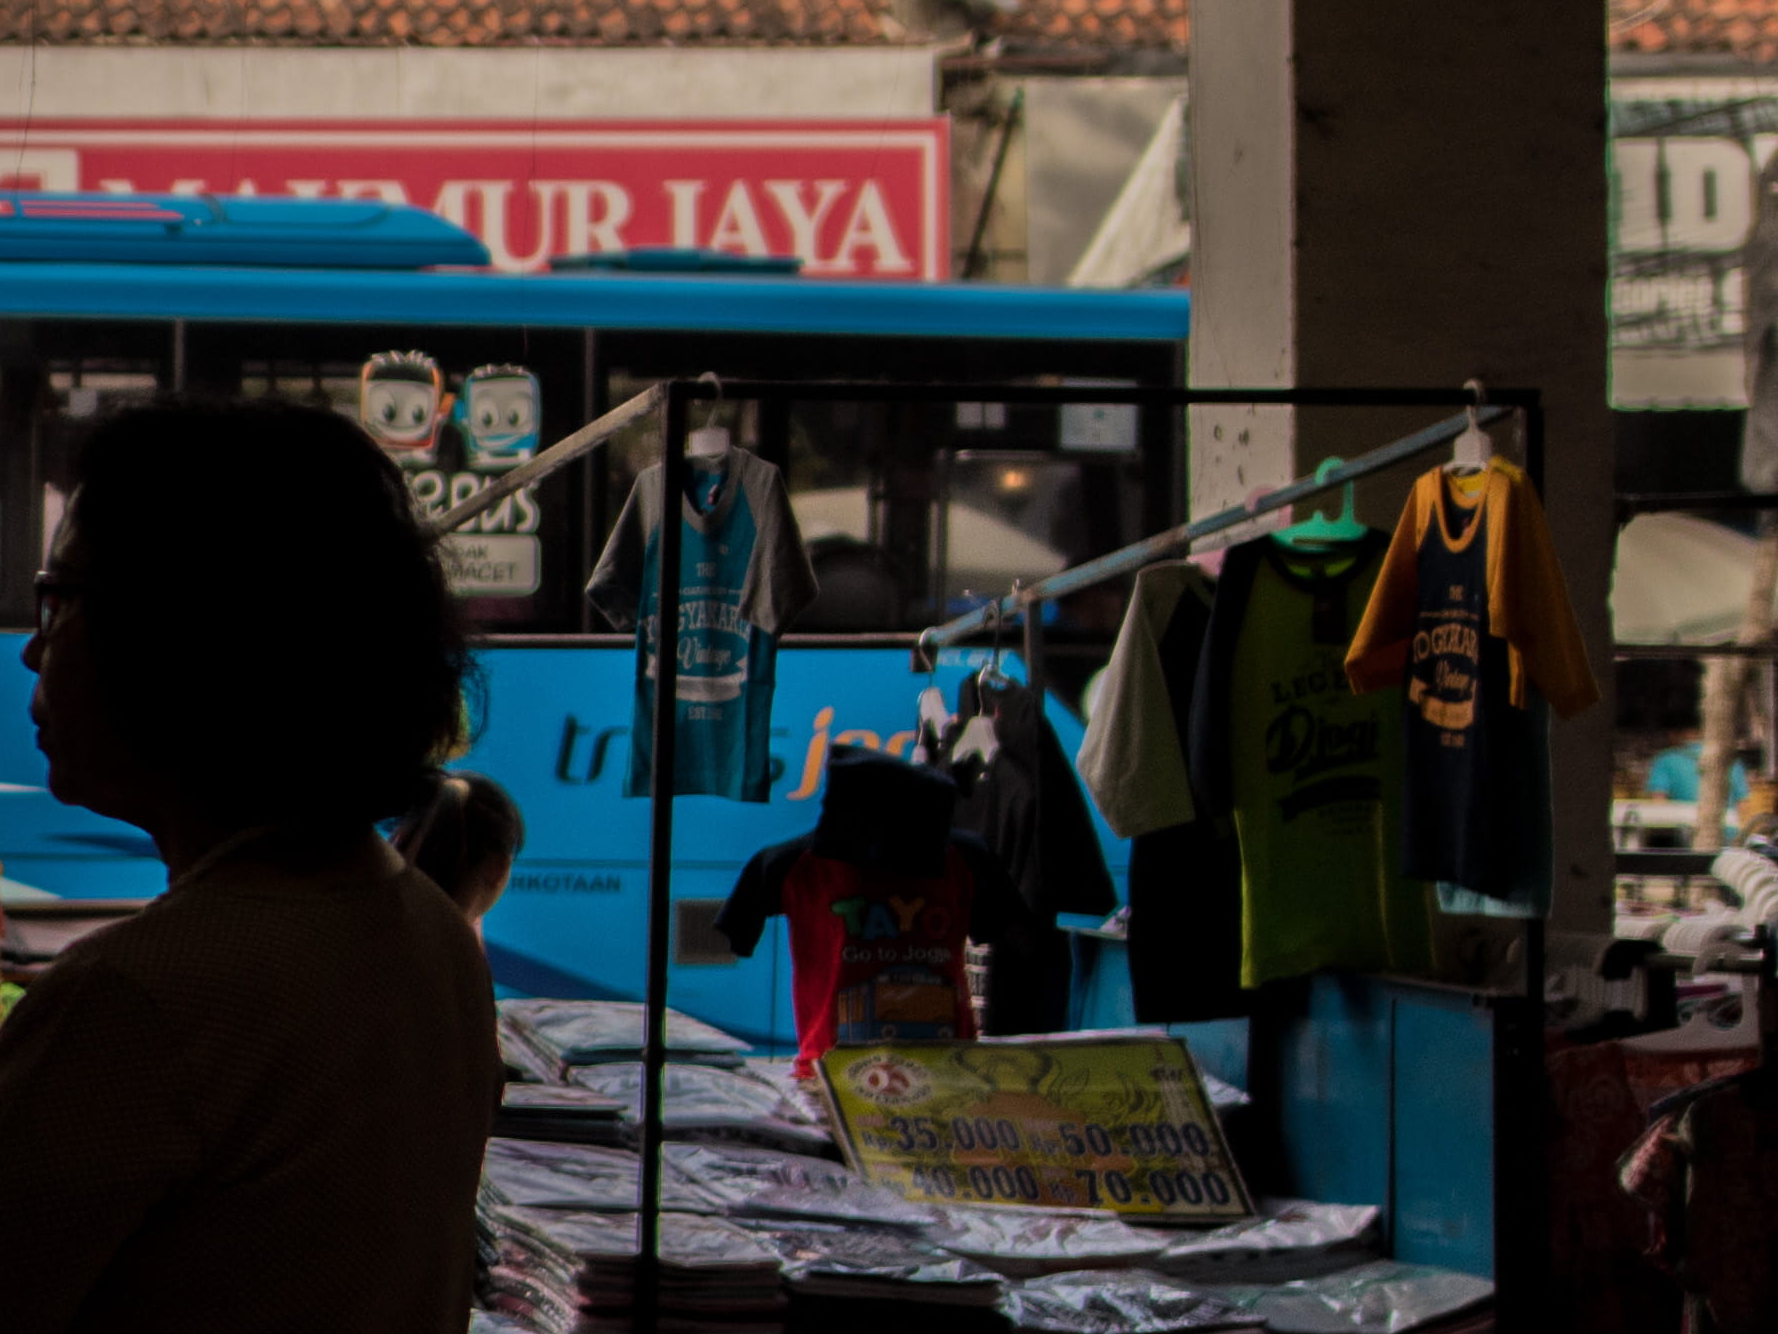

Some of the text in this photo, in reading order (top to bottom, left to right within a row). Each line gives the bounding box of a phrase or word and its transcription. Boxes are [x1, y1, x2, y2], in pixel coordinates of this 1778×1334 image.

[662, 178, 918, 274] JAYA
[831, 893, 950, 940] TAYO
[841, 943, 874, 964] Go
[890, 1115, 1021, 1152] 35.000
[1059, 1122, 1210, 1158] 50.000
[1074, 1169, 1231, 1206] 70.000
